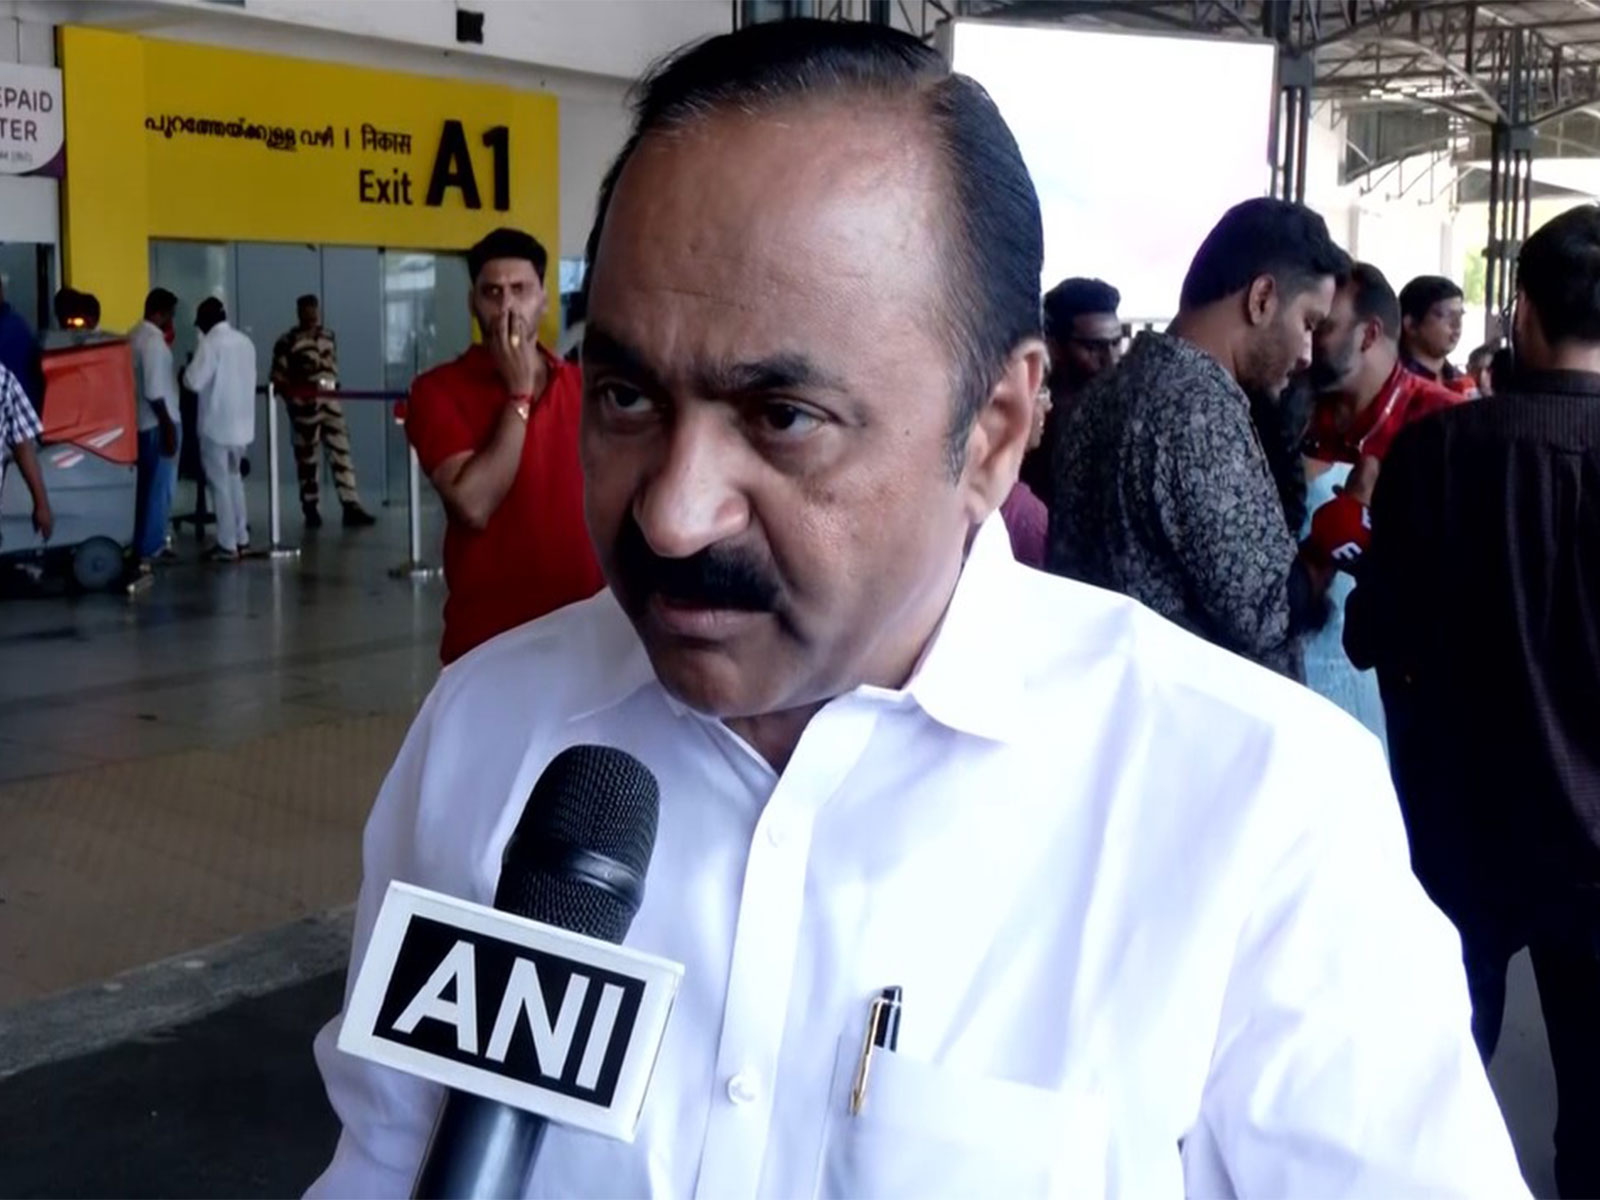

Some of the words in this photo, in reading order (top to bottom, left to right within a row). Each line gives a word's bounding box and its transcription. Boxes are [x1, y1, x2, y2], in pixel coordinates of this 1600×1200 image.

[0, 86, 53, 113] PAID
[361, 123, 412, 155] निकास
[425, 119, 509, 212] A1
[359, 168, 413, 206] Exit
[391, 939, 625, 1091] ANI
